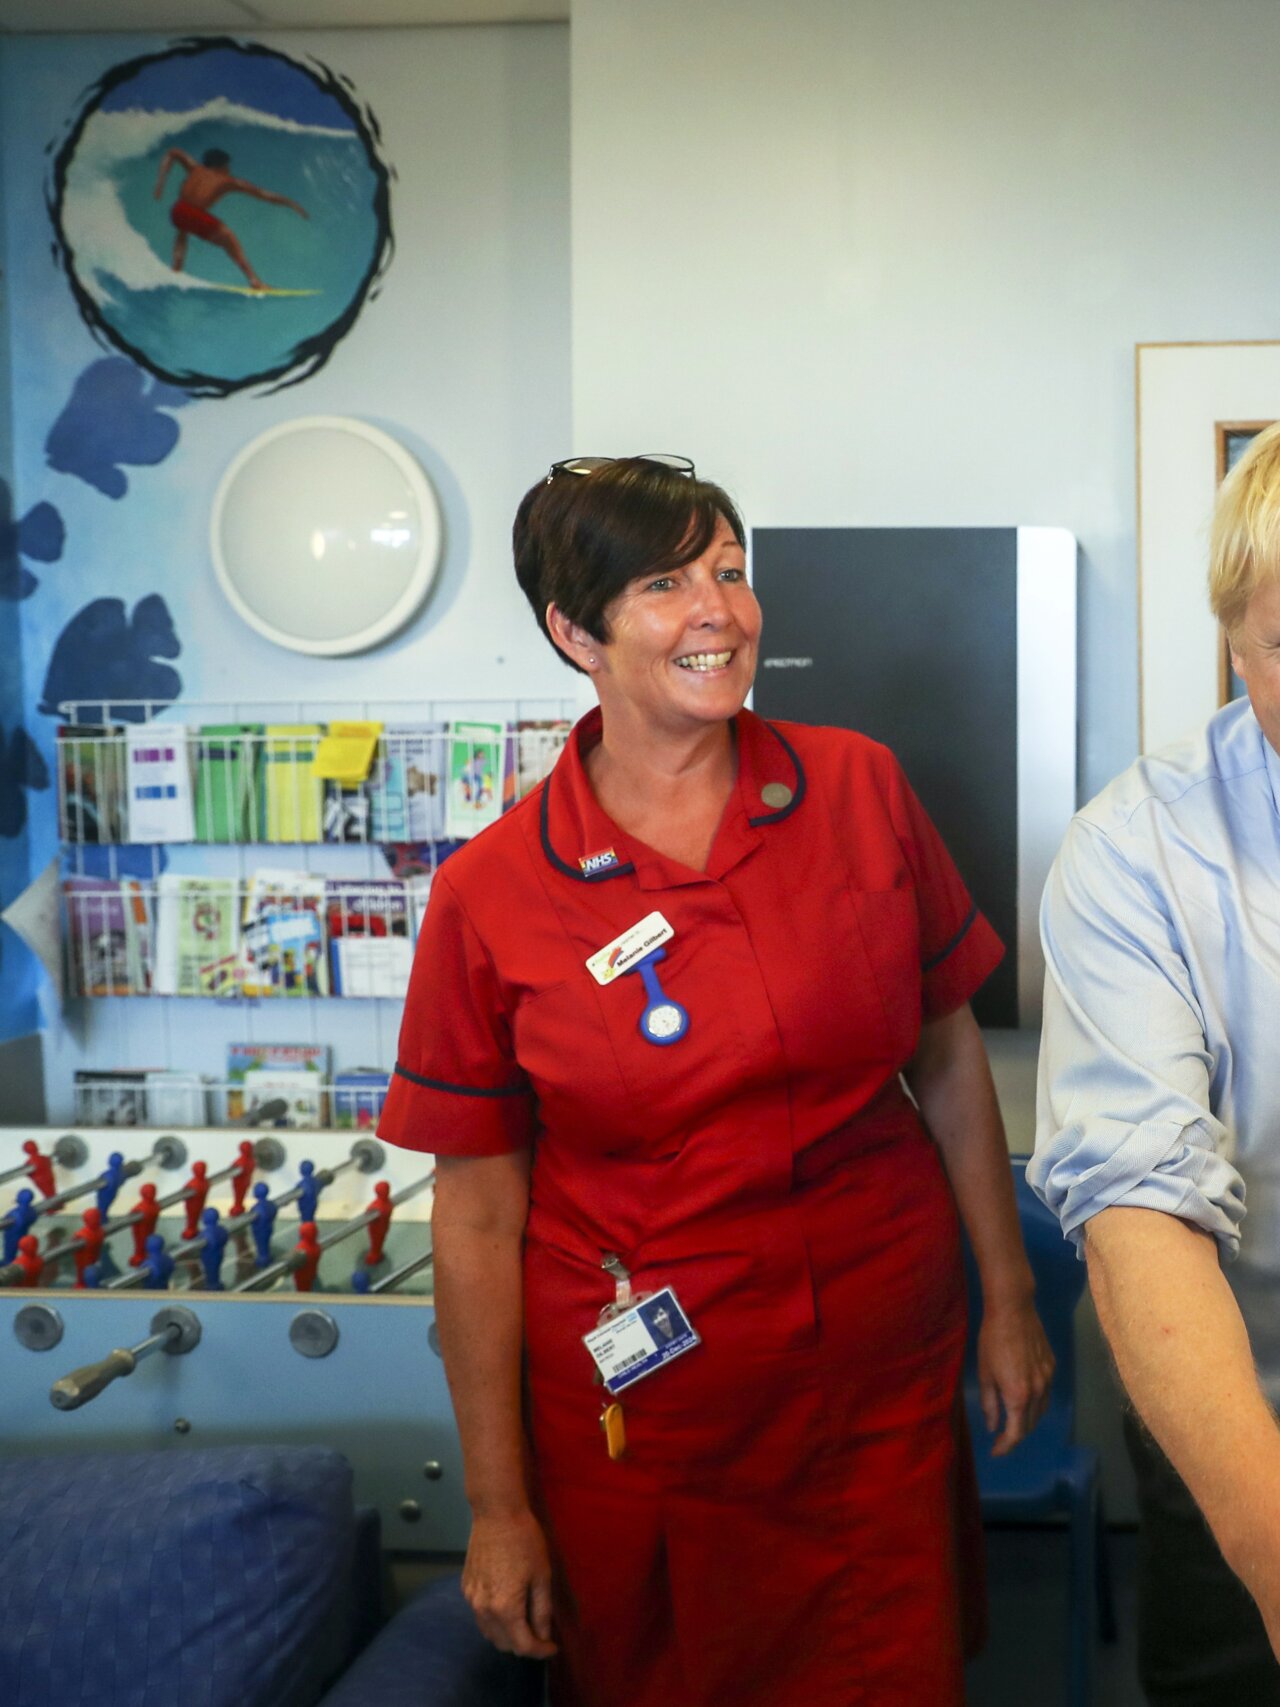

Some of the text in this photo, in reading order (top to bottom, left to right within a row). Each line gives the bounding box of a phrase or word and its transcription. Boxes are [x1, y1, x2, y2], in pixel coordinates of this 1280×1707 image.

[587, 853, 612, 871] NHS
[617, 946, 643, 966] Melanie
[643, 928, 667, 947] Gilbert
